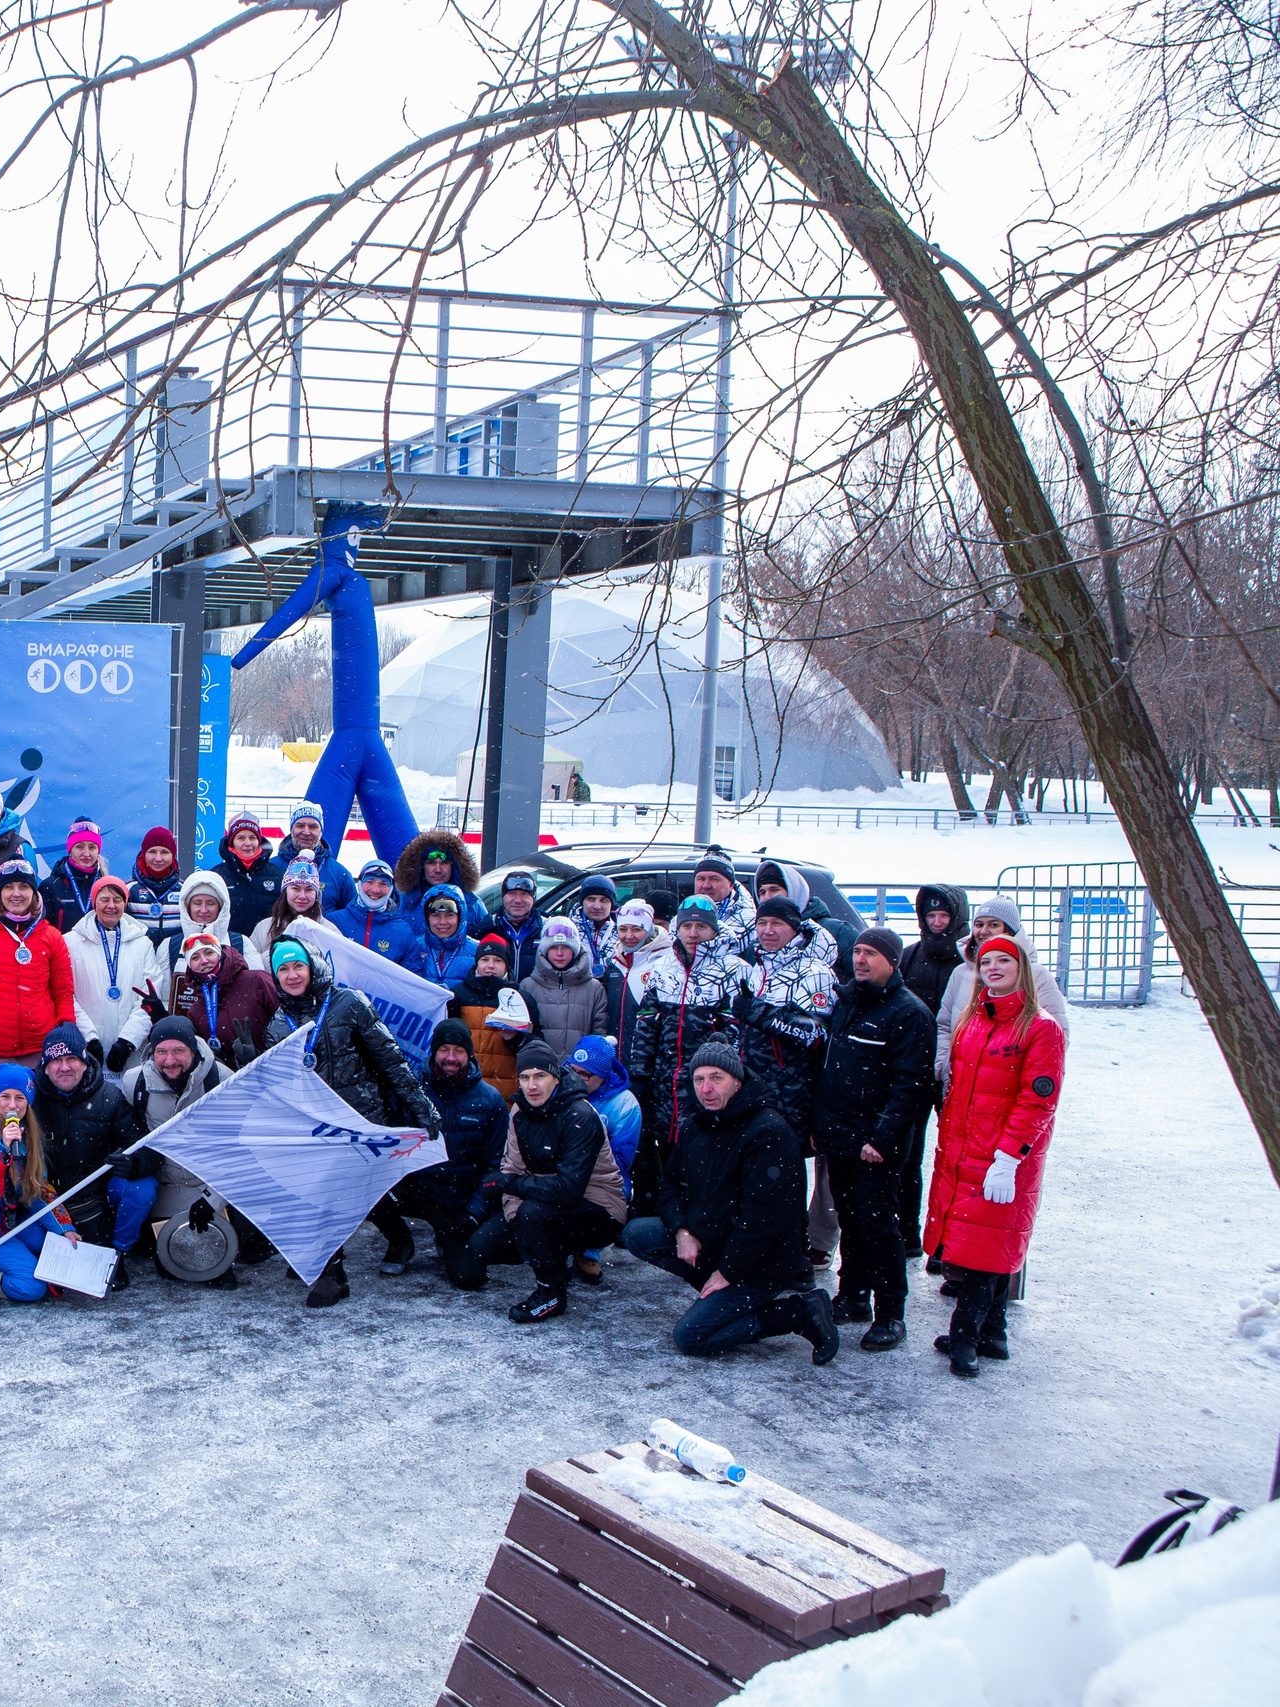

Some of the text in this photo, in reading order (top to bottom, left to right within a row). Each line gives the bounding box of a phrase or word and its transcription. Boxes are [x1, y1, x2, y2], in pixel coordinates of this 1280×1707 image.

[27, 642, 135, 658] ВМАРАФОНЕ
[178, 994, 199, 1002] МЕСТО
[530, 1297, 559, 1317] SPINE
